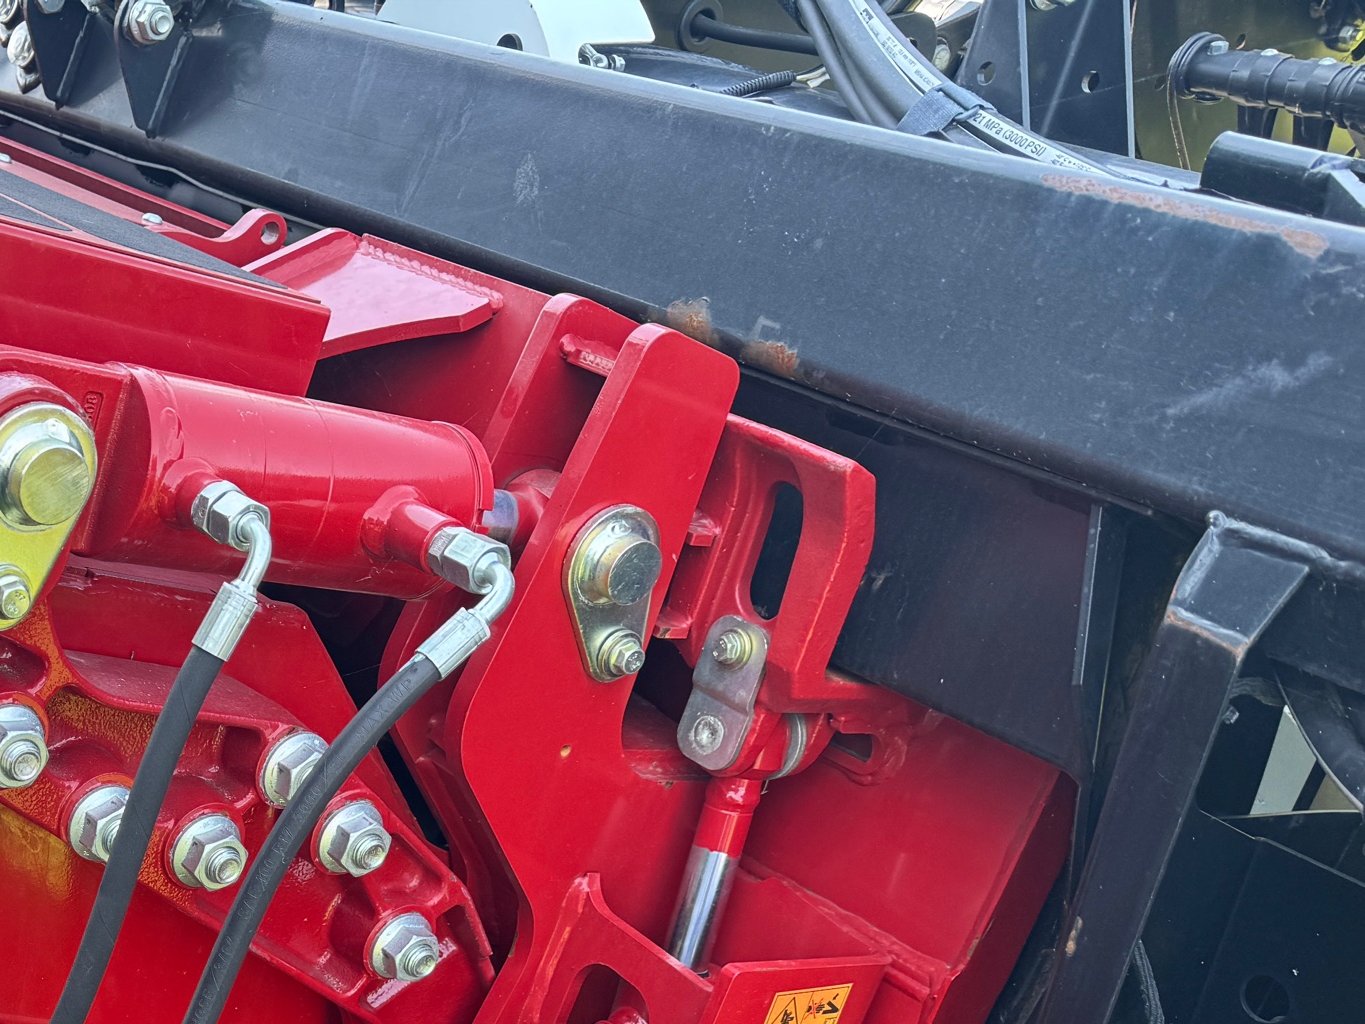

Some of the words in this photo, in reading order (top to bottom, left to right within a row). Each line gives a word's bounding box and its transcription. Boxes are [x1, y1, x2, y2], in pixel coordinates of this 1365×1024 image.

[982, 117, 1004, 135] MPa
[1001, 127, 1029, 149] (3000
[1023, 138, 1047, 158] PSI)
[352, 702, 390, 741] MAX
[386, 675, 415, 705] WP
